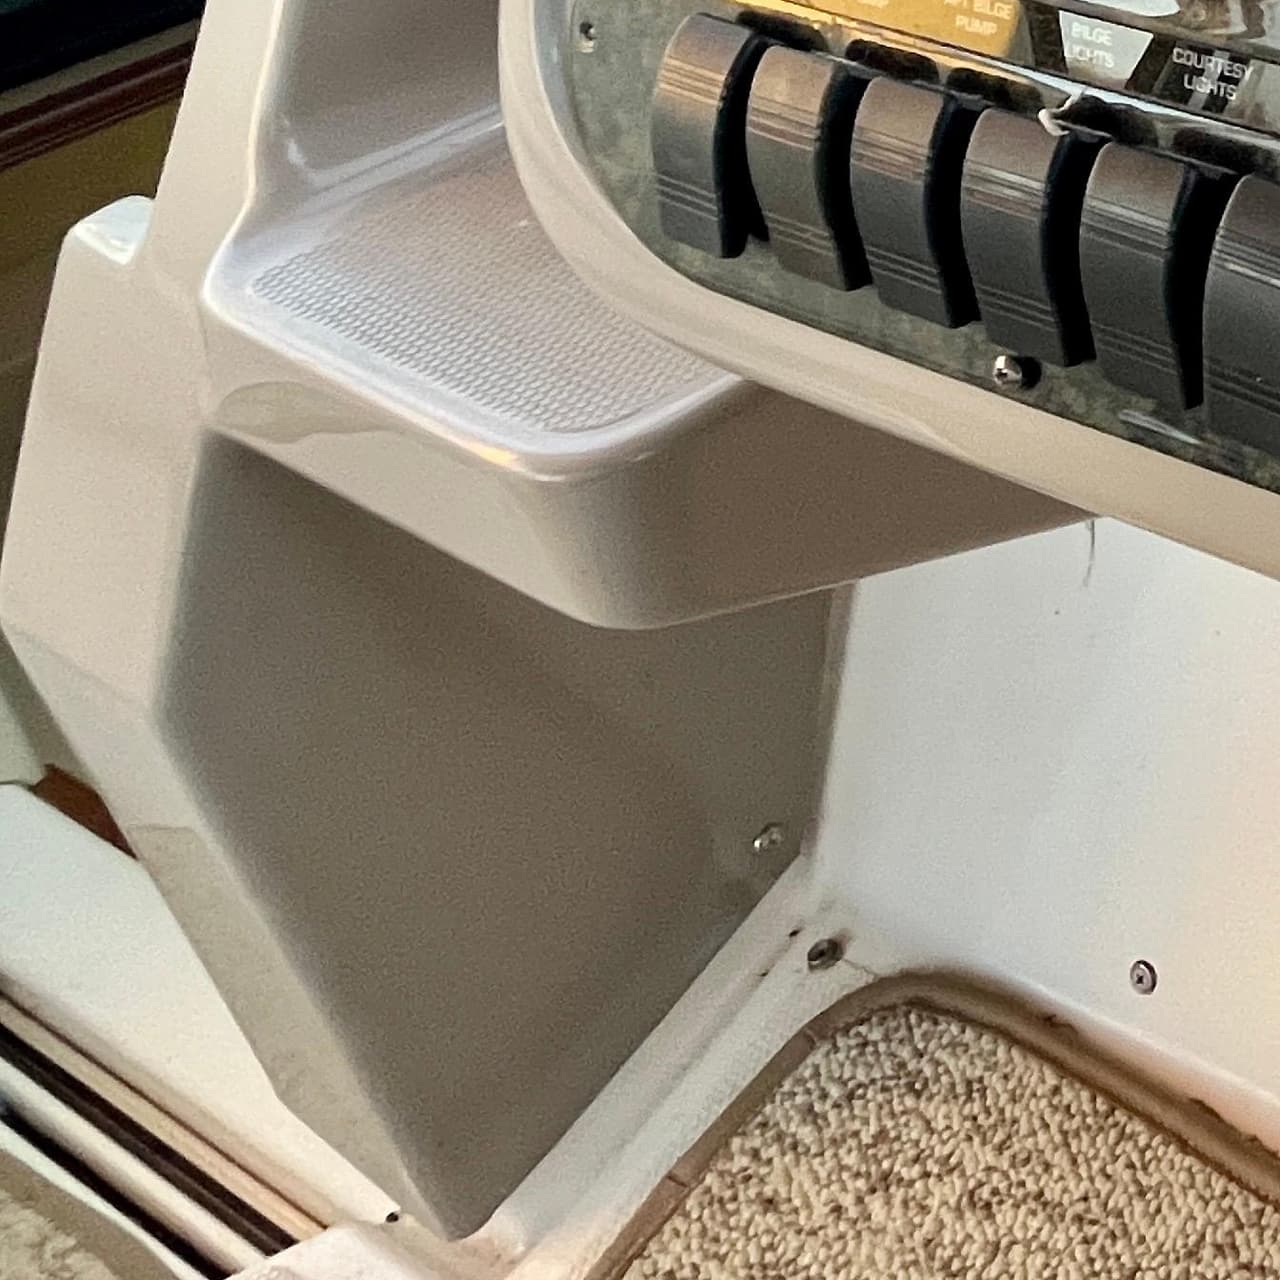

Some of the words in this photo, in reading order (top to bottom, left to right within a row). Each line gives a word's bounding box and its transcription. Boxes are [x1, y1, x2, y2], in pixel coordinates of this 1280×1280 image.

[955, 15, 997, 36] PUMP
[1071, 22, 1112, 46] BILGE
[1065, 43, 1114, 68] LIGHTS
[1172, 47, 1253, 80] COURTESY
[1184, 75, 1237, 100] LIGHTS
